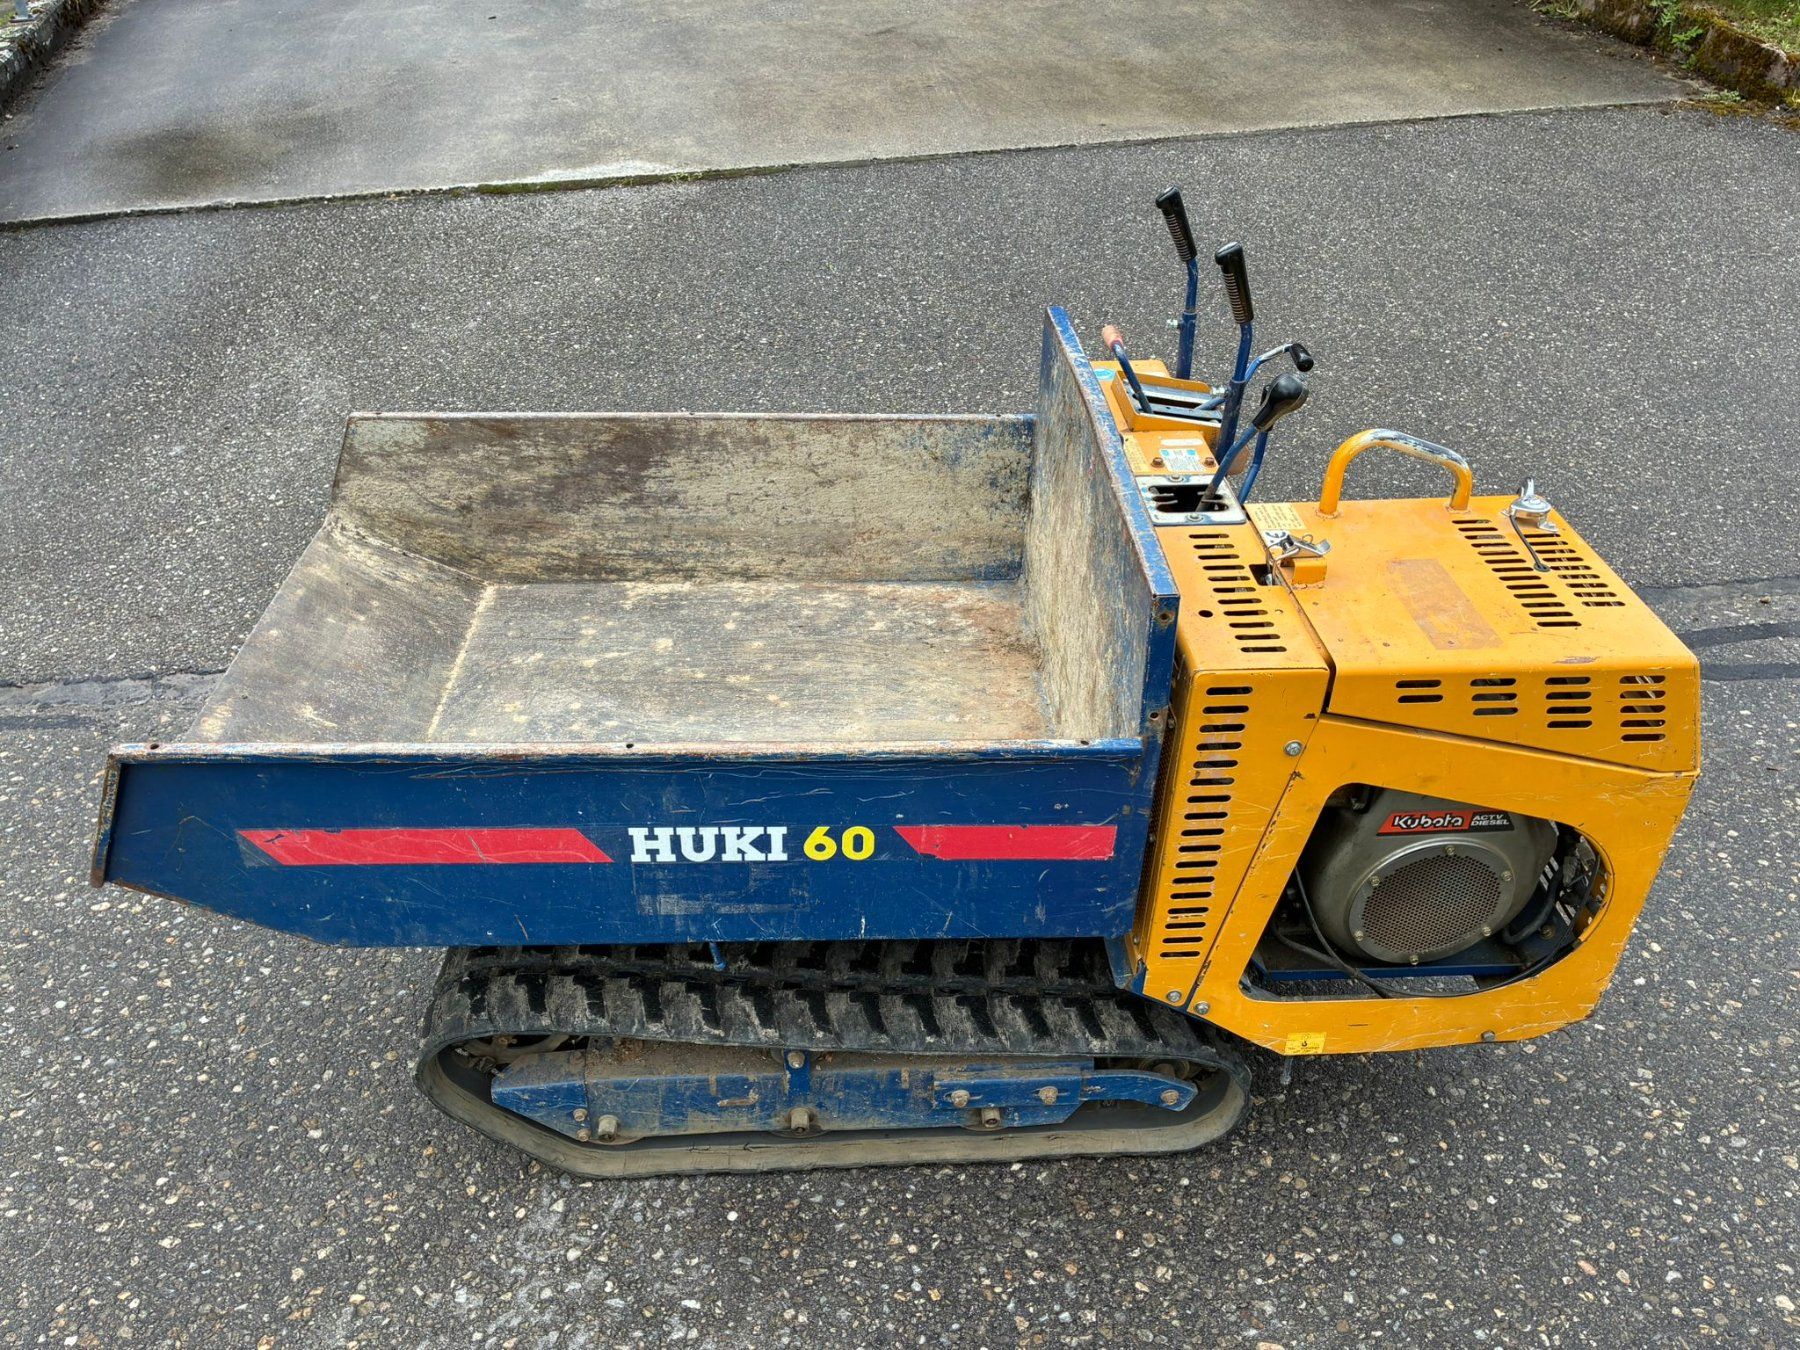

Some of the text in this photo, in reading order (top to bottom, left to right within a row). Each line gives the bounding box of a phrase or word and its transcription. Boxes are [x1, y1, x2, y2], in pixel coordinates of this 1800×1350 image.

[1394, 813, 1463, 829] Kubota
[628, 825, 875, 863] HUKI 60
